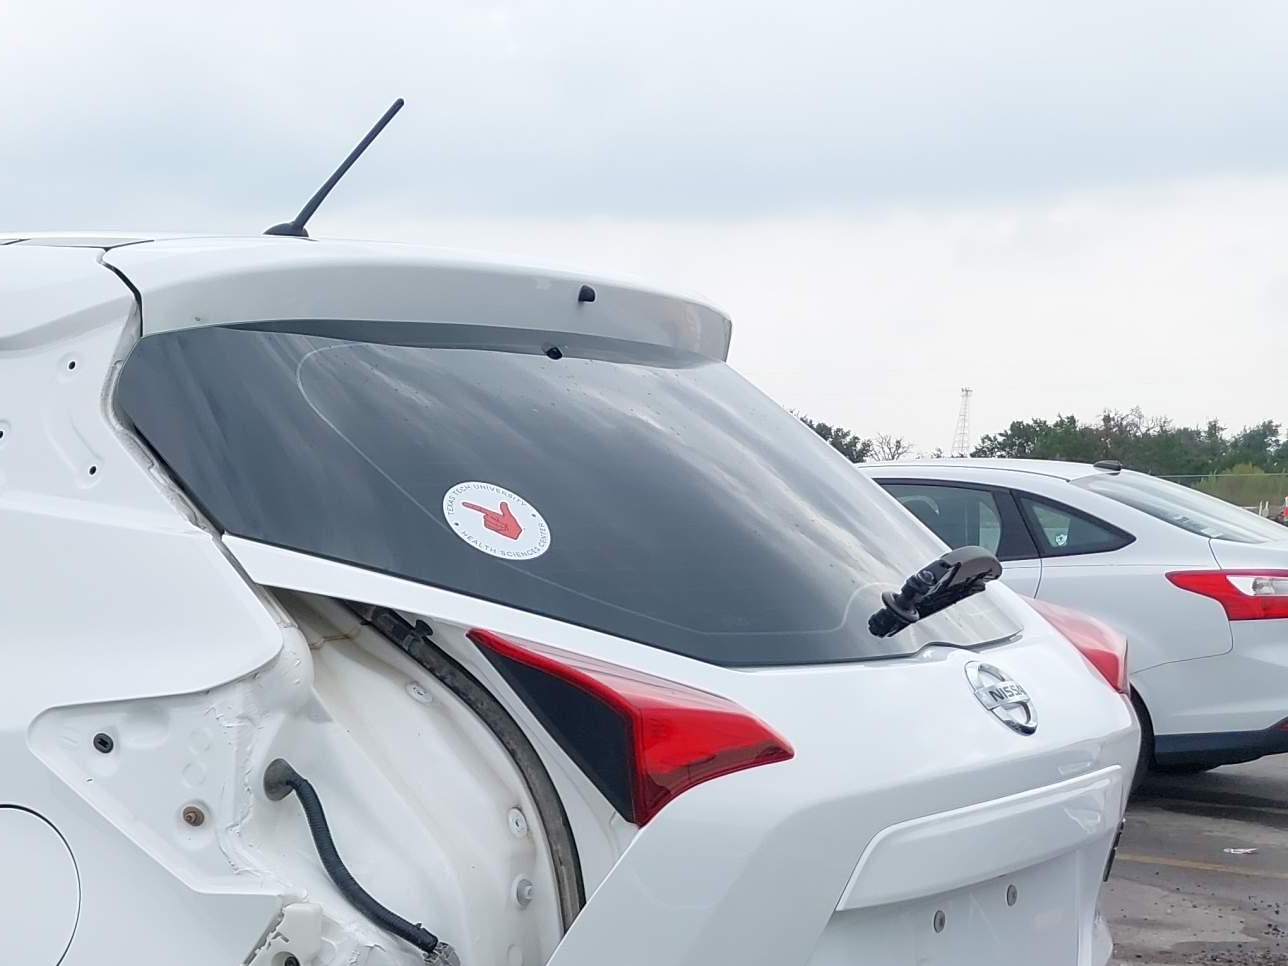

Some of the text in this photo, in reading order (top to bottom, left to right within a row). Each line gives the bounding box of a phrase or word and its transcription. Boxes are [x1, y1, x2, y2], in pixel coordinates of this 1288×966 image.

[447, 484, 527, 515] TEXAS TECH UNIVERSITY
[462, 522, 547, 558] HEALTH SCIENCES CENTER
